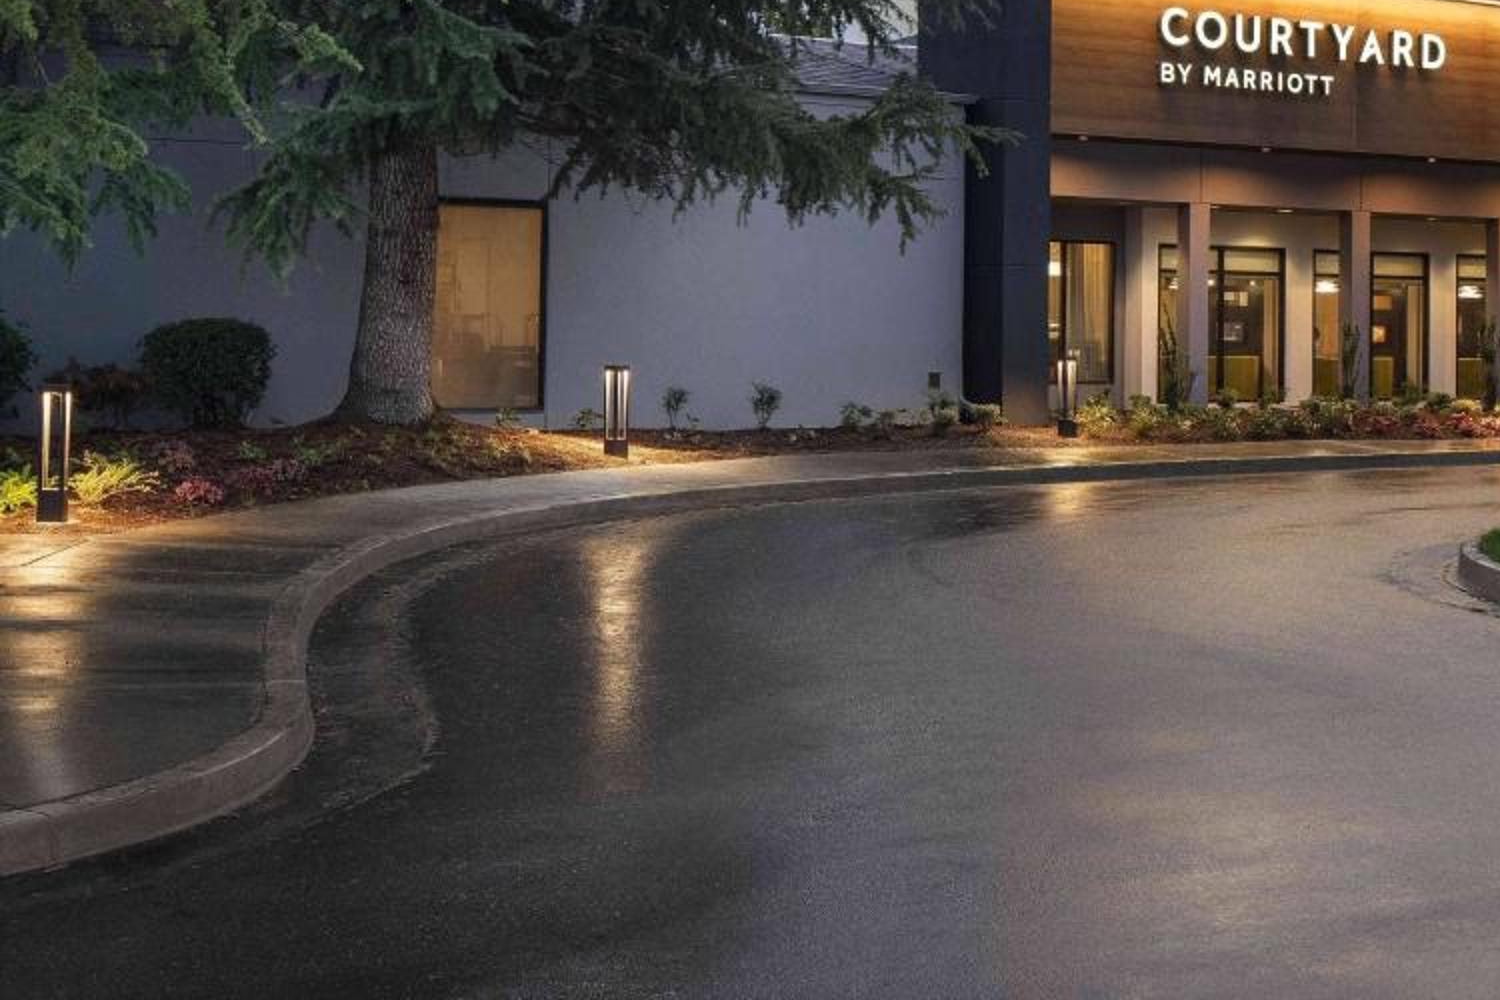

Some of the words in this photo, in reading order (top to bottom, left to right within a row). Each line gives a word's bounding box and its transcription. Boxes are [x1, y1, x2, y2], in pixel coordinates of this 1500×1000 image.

[1160, 7, 1447, 70] COURTYARD
[1160, 62, 1192, 84] BY
[1203, 65, 1335, 95] MARRIOTT
